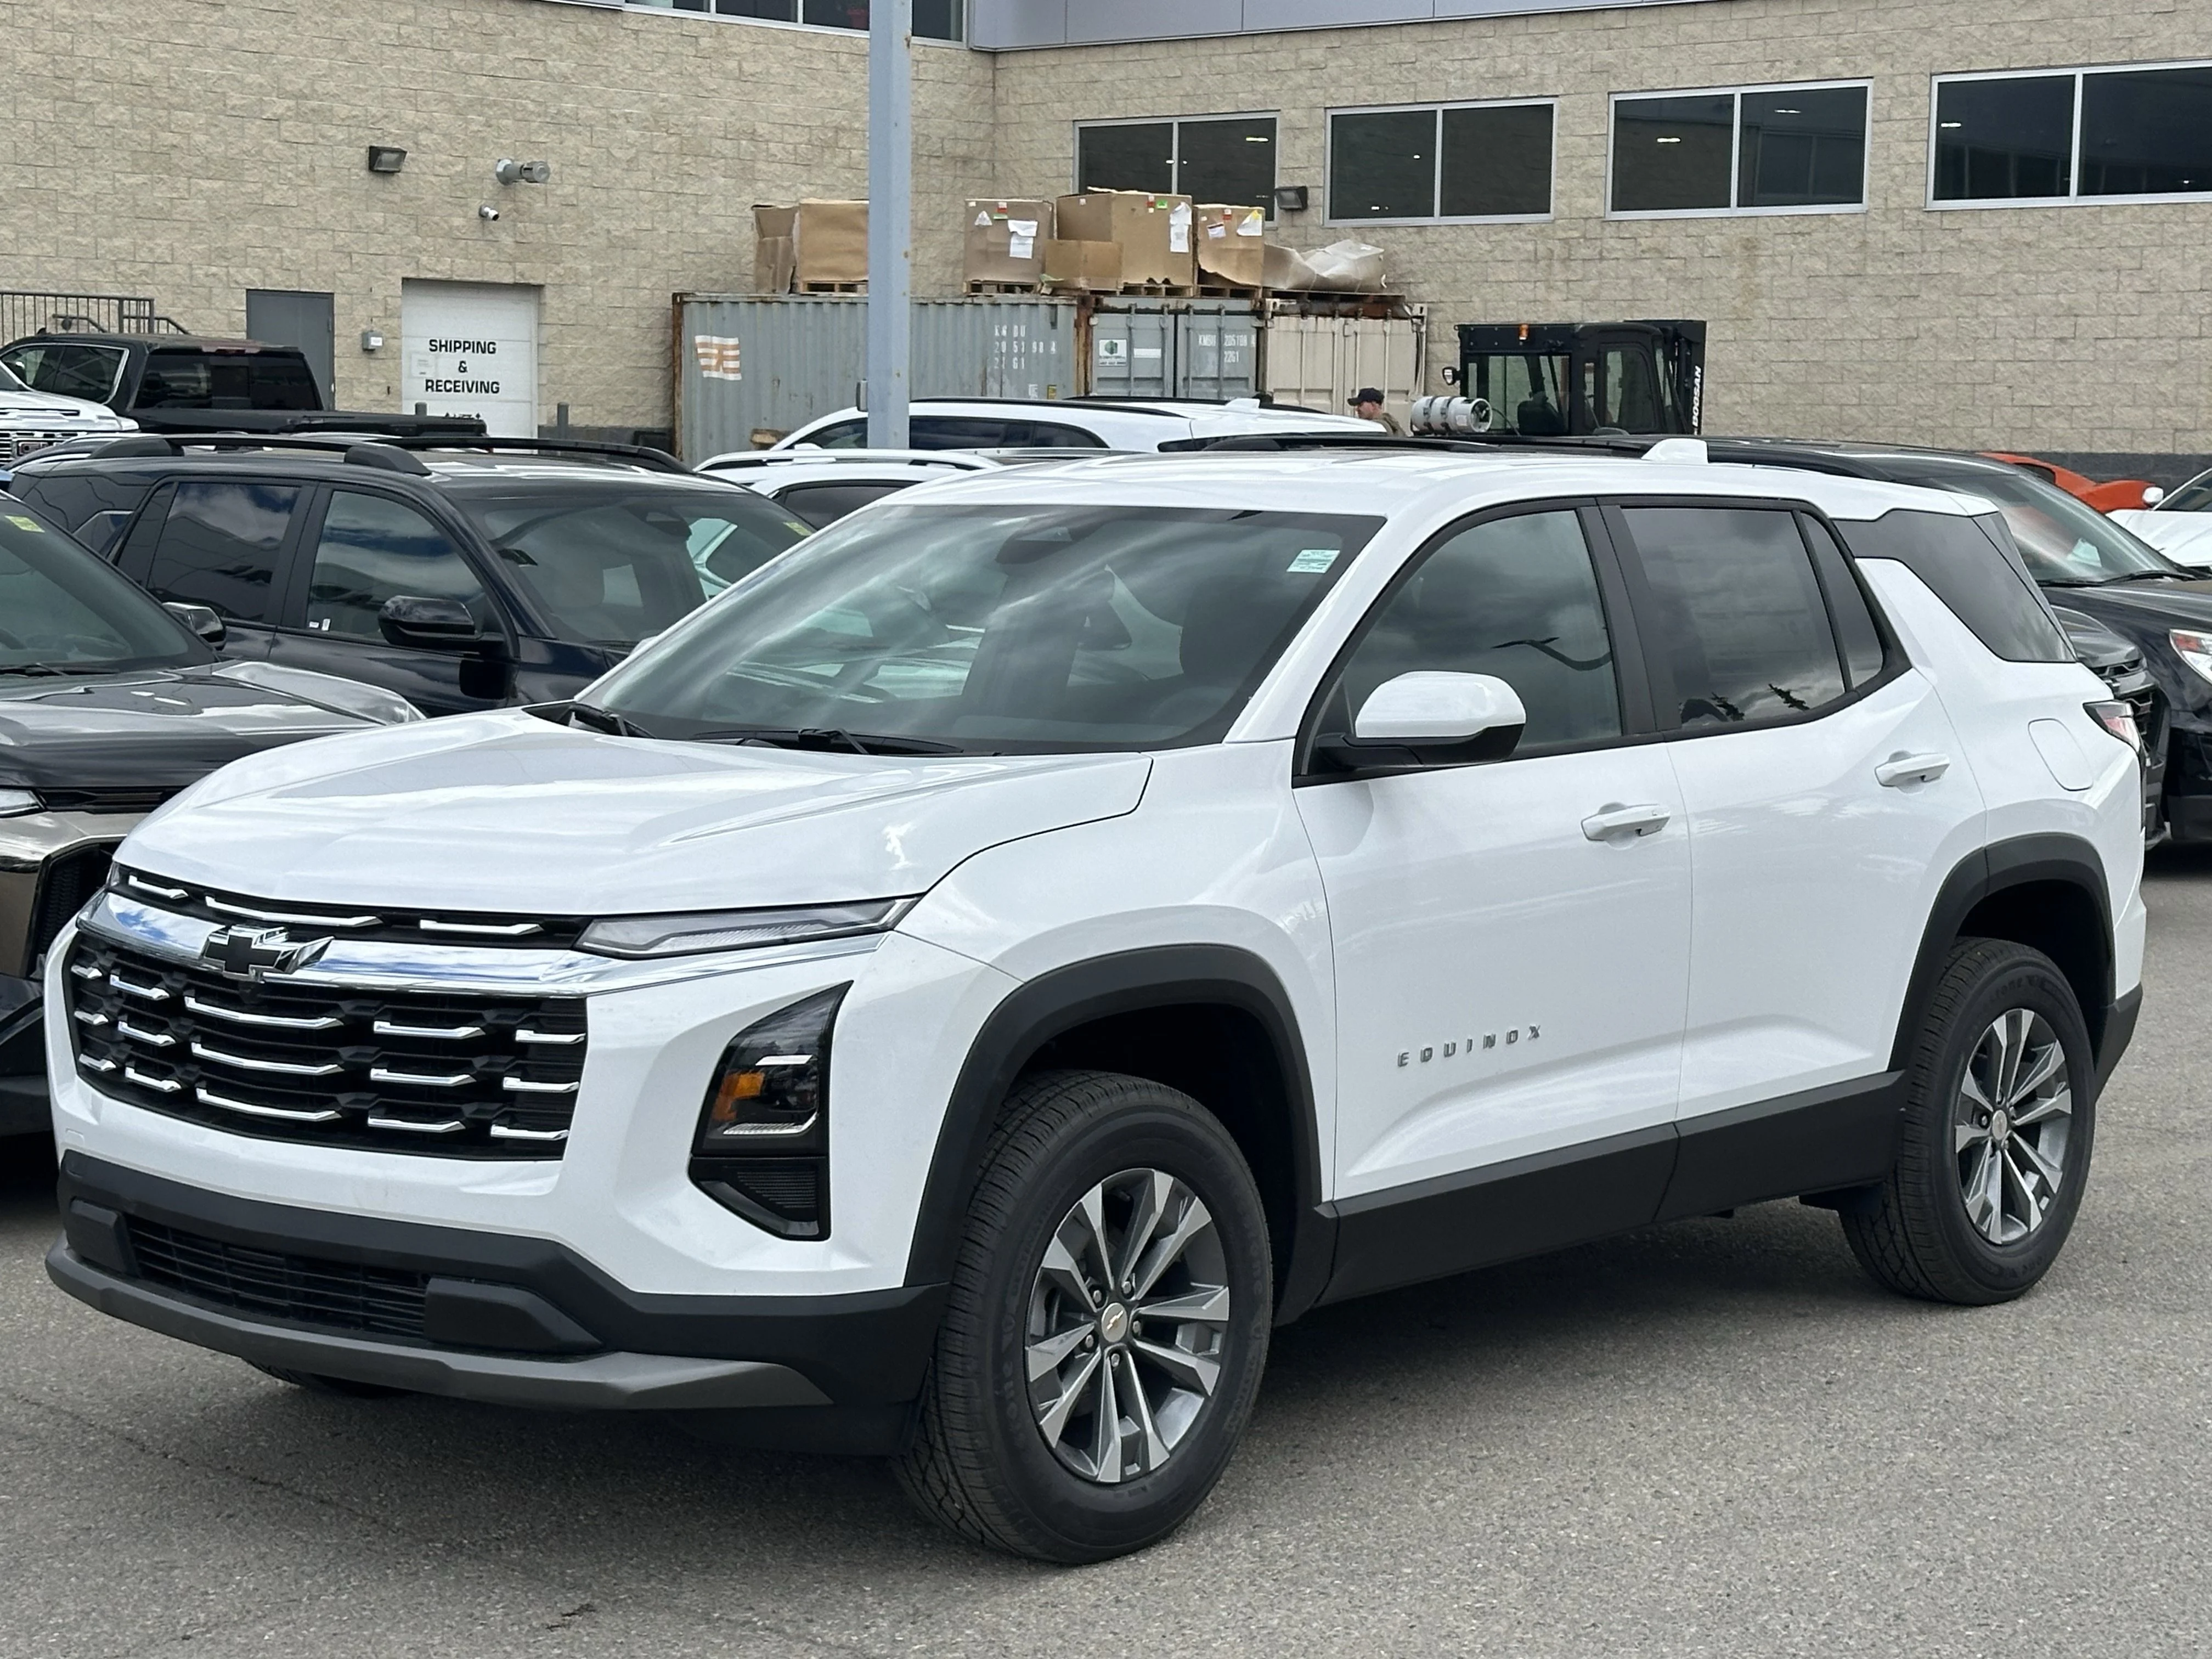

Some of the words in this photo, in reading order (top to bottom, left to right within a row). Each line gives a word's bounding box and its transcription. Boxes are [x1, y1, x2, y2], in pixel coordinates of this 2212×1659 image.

[429, 339, 496, 354] SHIPPING
[458, 360, 467, 373] &
[425, 379, 500, 393] RECEIVING
[1692, 365, 1701, 427] DOOSAN
[1397, 1024, 1541, 1067] EQUINOX
